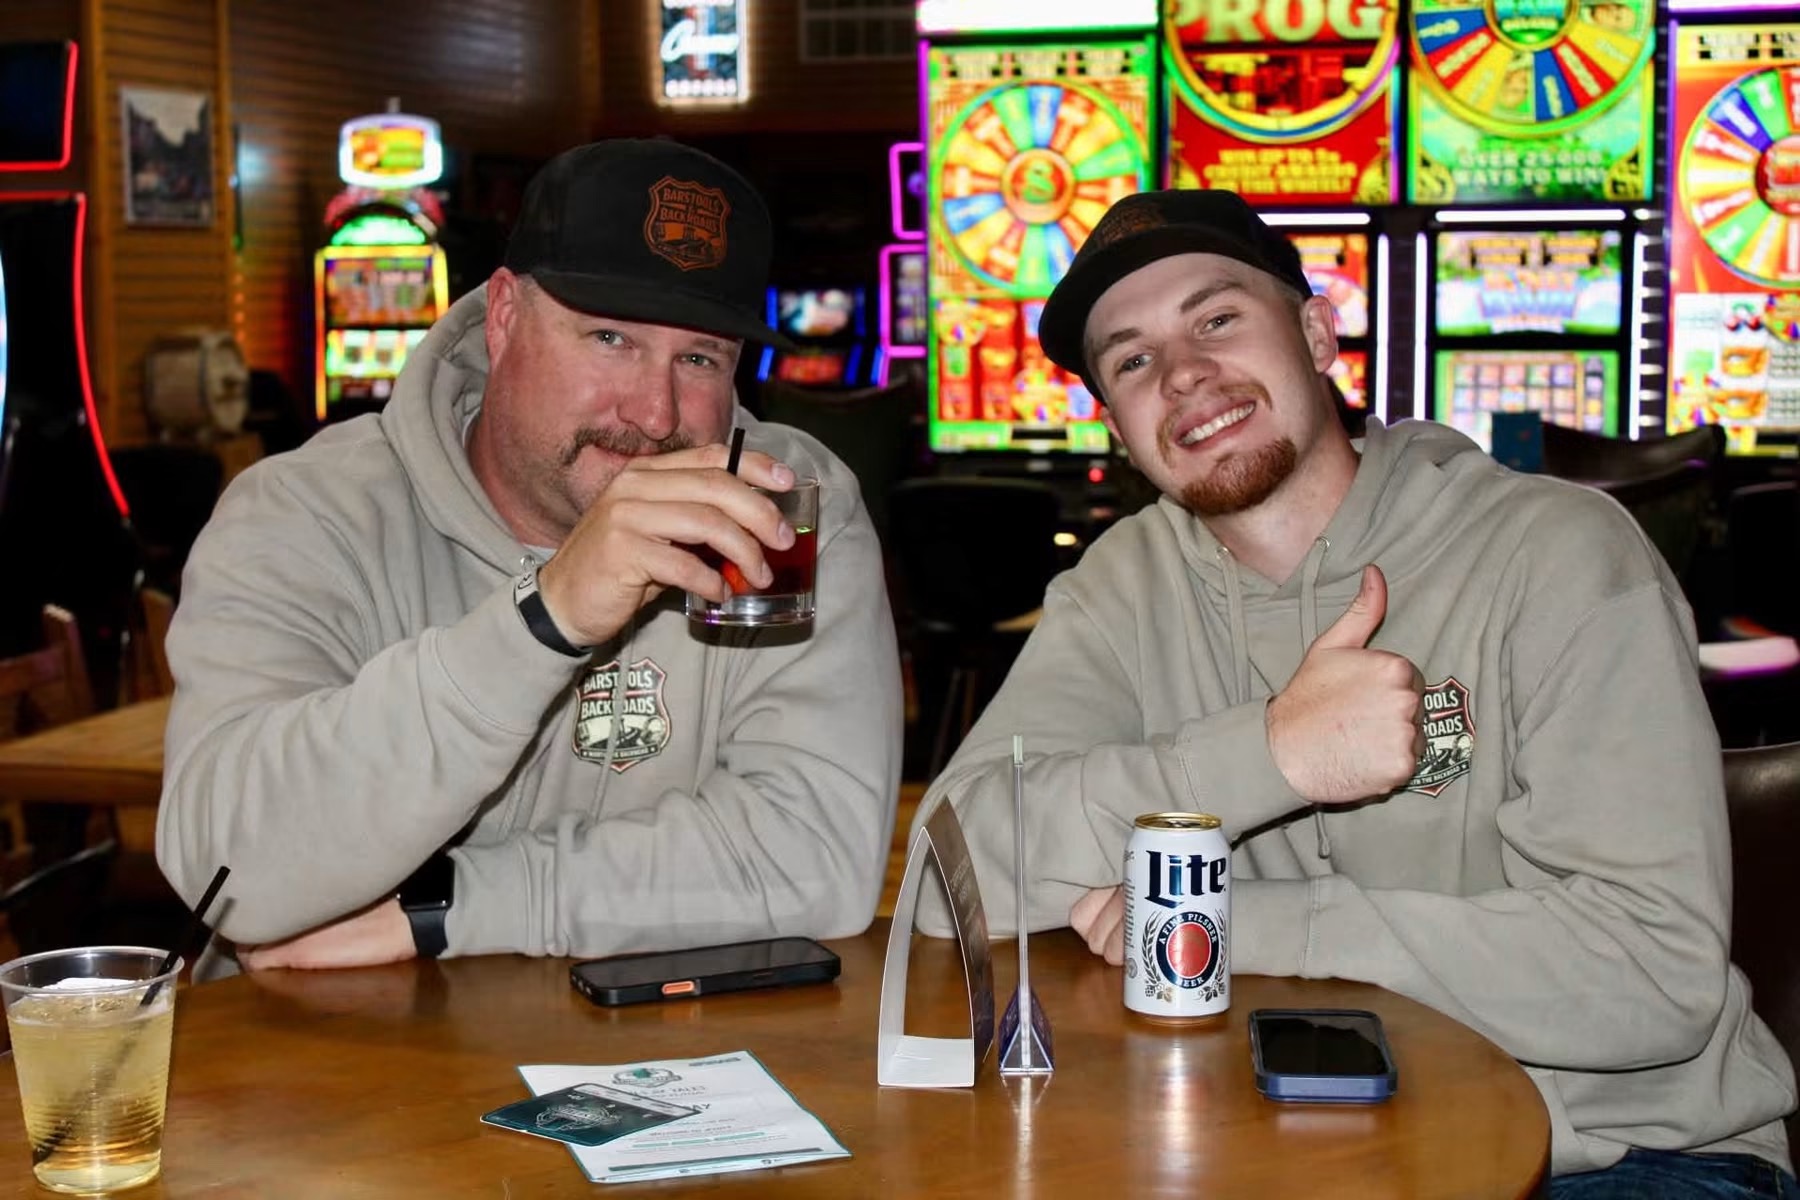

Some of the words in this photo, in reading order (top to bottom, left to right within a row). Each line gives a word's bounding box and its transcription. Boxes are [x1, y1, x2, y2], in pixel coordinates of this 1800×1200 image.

[1458, 150, 1518, 167] OVER
[1452, 168, 1518, 186] WAYS
[1521, 168, 1552, 185] TO
[663, 188, 720, 214] BARSTOOLS
[660, 207, 718, 233] BACKROADS
[583, 670, 654, 694] BARSTOLS
[581, 696, 656, 719] BACKOADS
[1144, 849, 1227, 909] Lite
[1159, 937, 1167, 945] A
[1163, 914, 1185, 933] FINE
[1188, 913, 1218, 943] PILSNER
